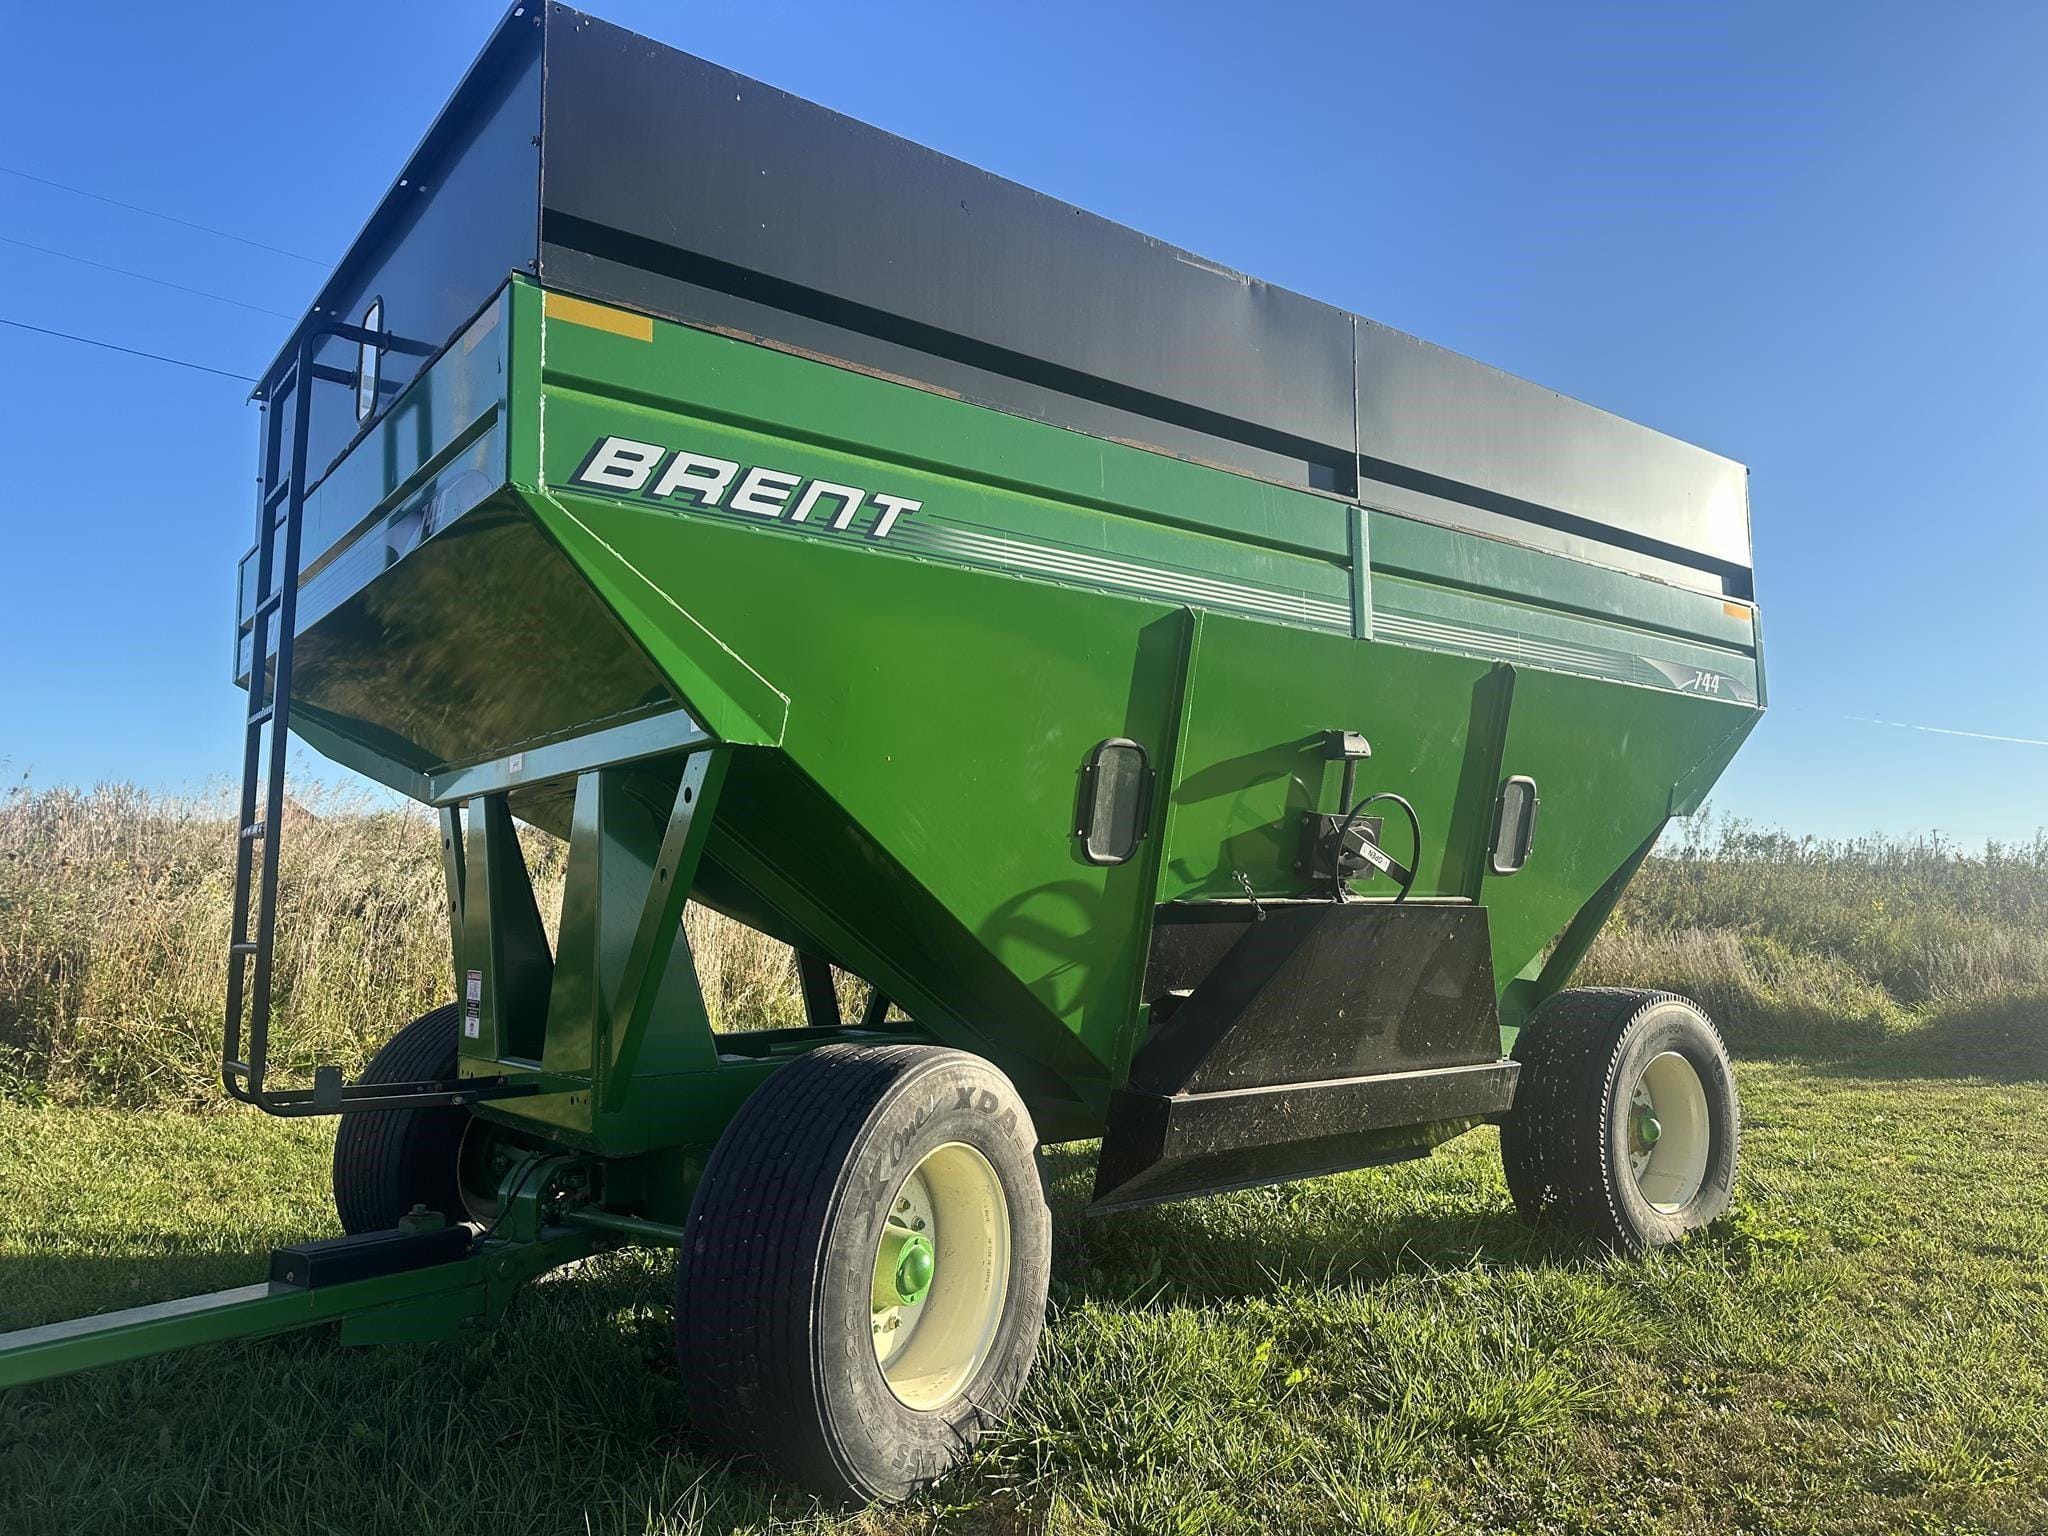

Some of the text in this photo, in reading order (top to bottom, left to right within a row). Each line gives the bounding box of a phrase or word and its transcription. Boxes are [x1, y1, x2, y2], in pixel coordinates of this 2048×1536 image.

[574, 434, 924, 538] BRENT
[418, 489, 447, 542] 744
[1693, 671, 1720, 694] 744
[1367, 849, 1383, 864] OPEN
[854, 1153, 890, 1242] X
[890, 1096, 942, 1168] One
